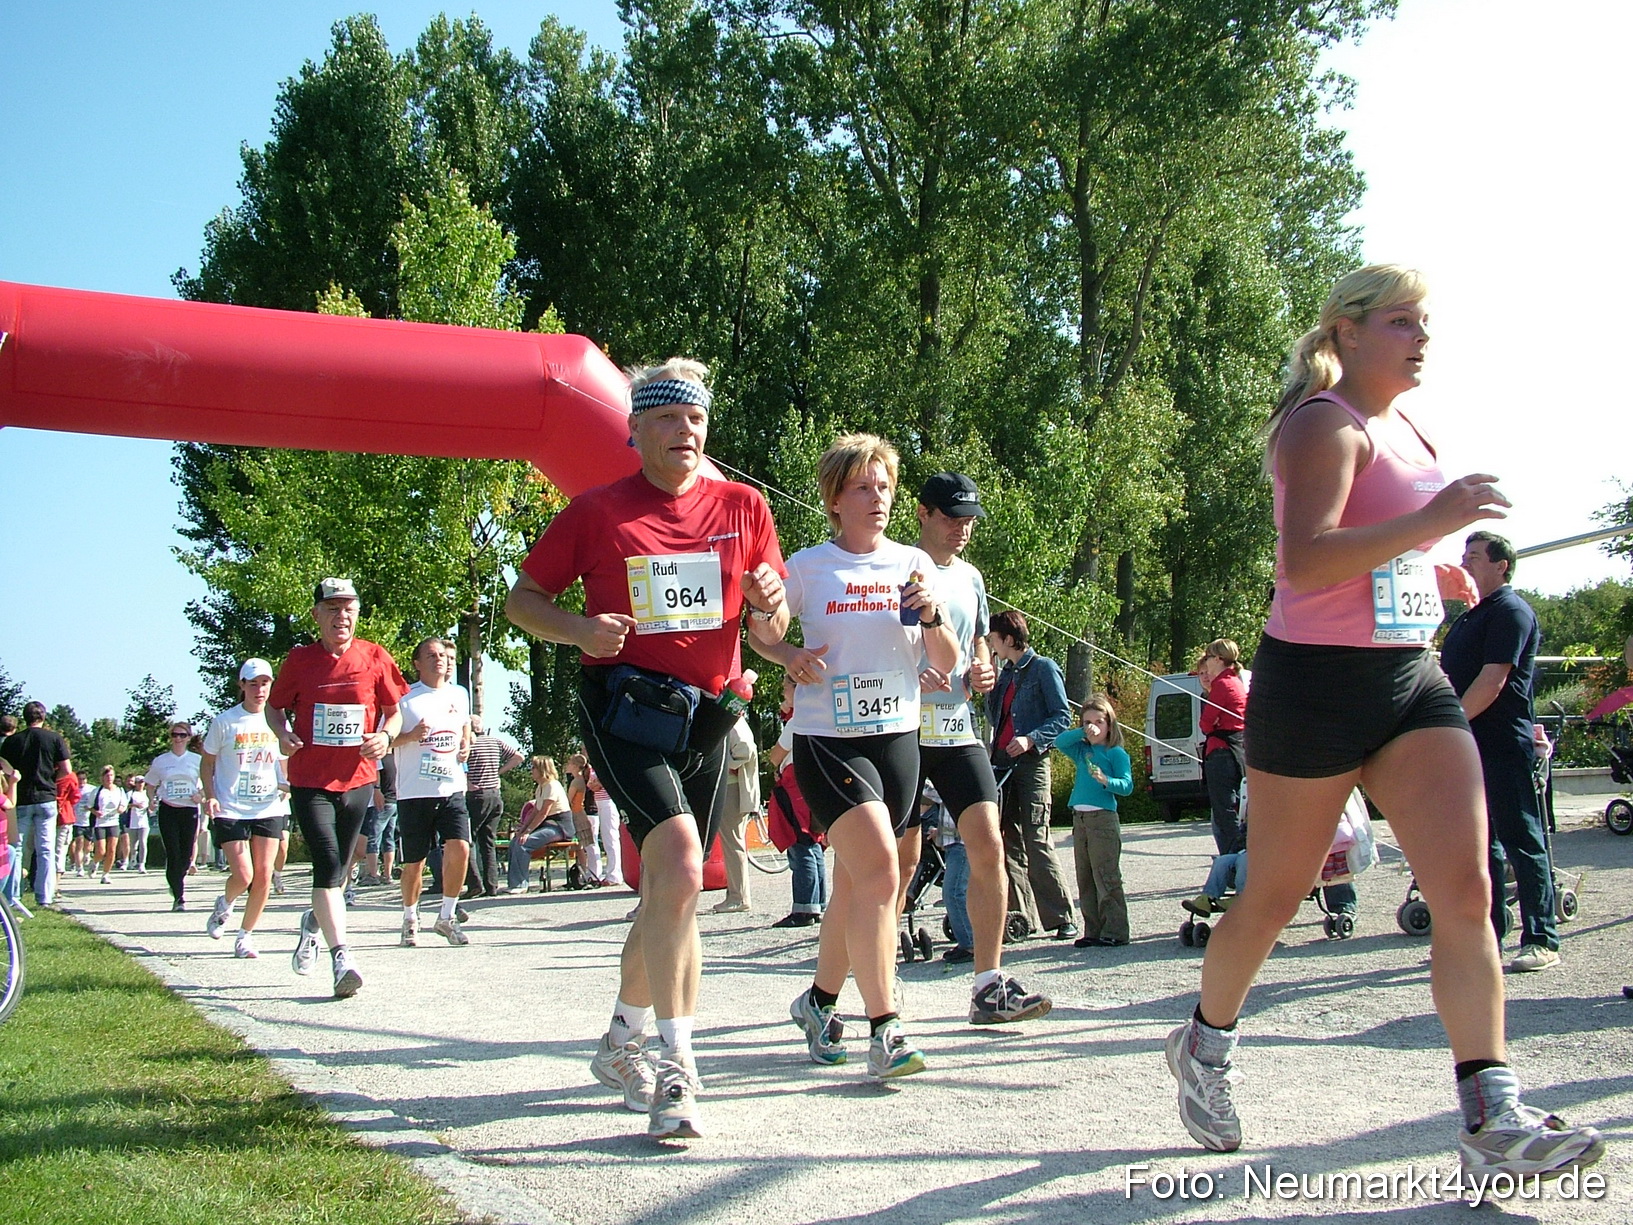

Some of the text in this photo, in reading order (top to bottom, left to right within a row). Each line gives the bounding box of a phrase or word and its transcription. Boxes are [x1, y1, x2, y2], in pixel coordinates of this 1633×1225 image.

[652, 561, 678, 577] Rudi
[845, 581, 891, 598] Angelas
[1377, 586, 1384, 600] C
[664, 586, 708, 609] 964
[826, 598, 899, 615] Marathon-Te
[853, 676, 884, 691] Conny
[327, 707, 348, 719] Georg
[857, 695, 900, 717] 3451
[327, 722, 361, 735] 2657
[942, 718, 965, 733] 736
[250, 784, 272, 794] 324
